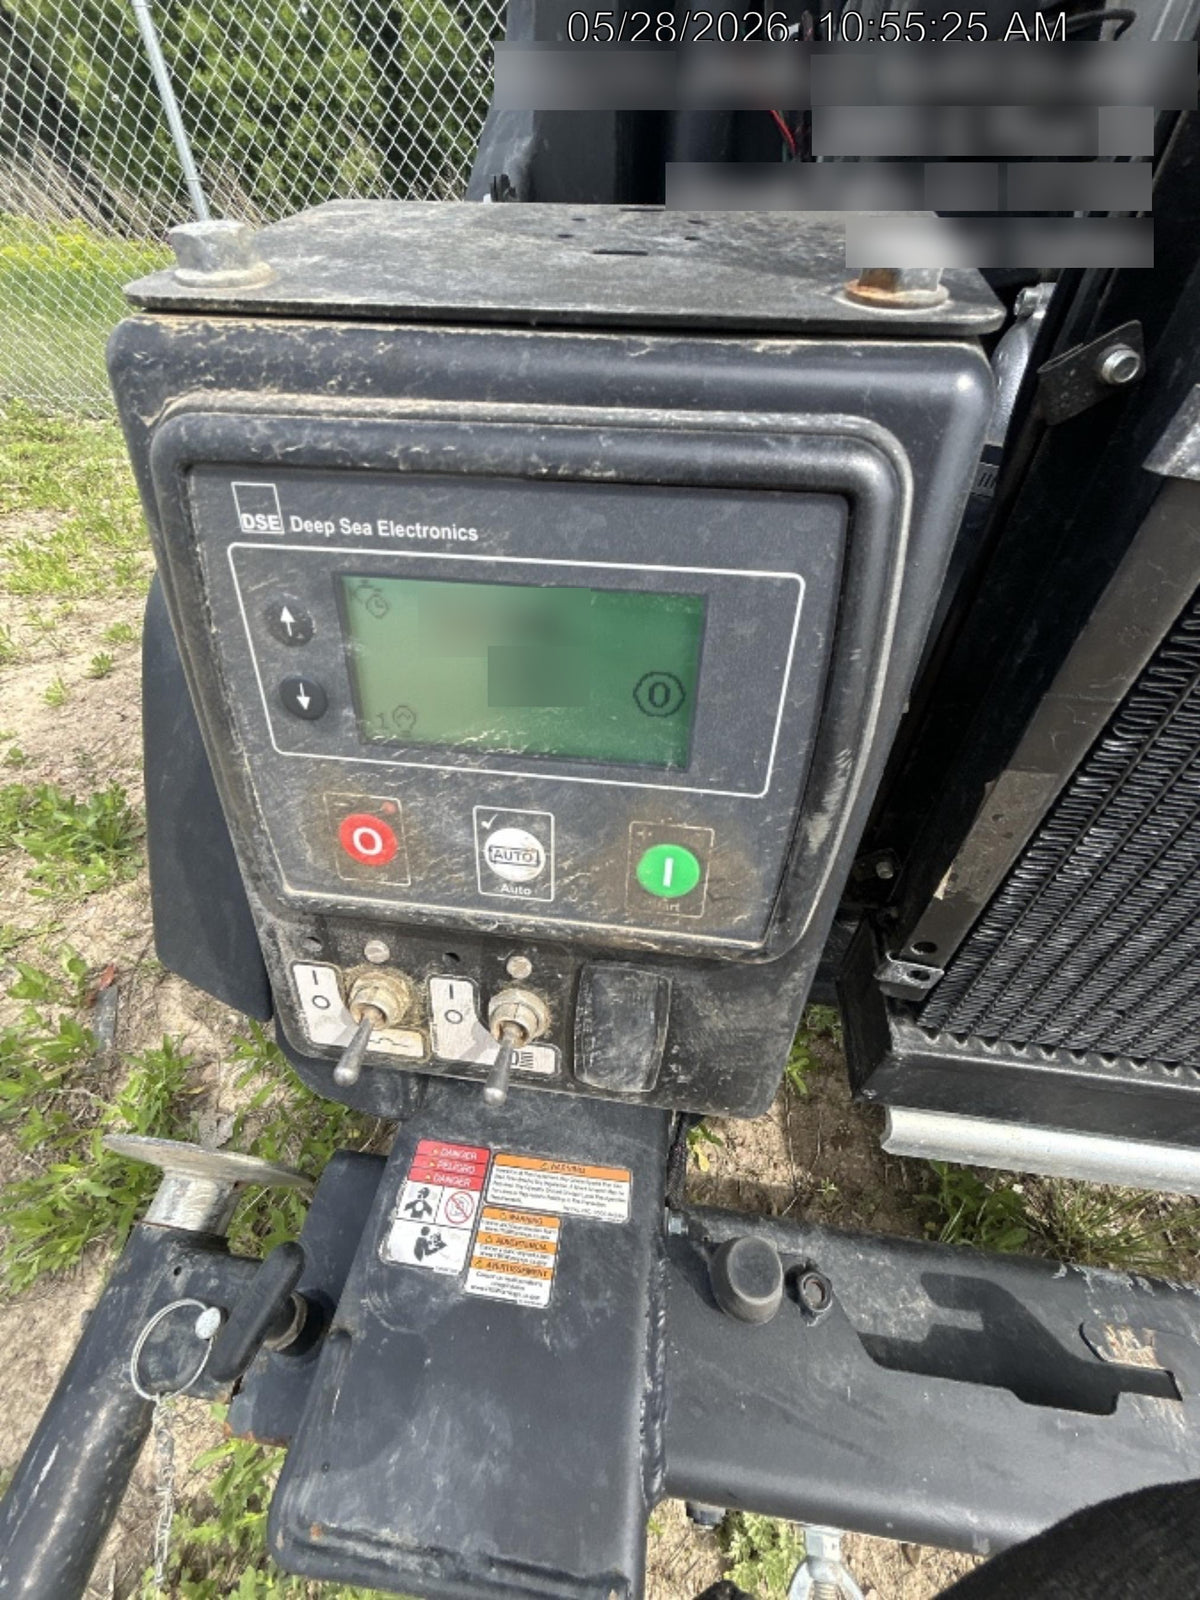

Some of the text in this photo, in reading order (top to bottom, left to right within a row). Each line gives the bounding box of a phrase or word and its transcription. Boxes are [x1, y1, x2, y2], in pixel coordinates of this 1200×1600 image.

[240, 513, 281, 531] DSE
[290, 515, 479, 541] Deep Sea Electronics
[493, 849, 533, 863] AUTO
[500, 883, 532, 896] Auto
[441, 1147, 477, 1161] DANGER
[436, 1159, 476, 1175] PELIGRO
[433, 1173, 471, 1188] DANGER
